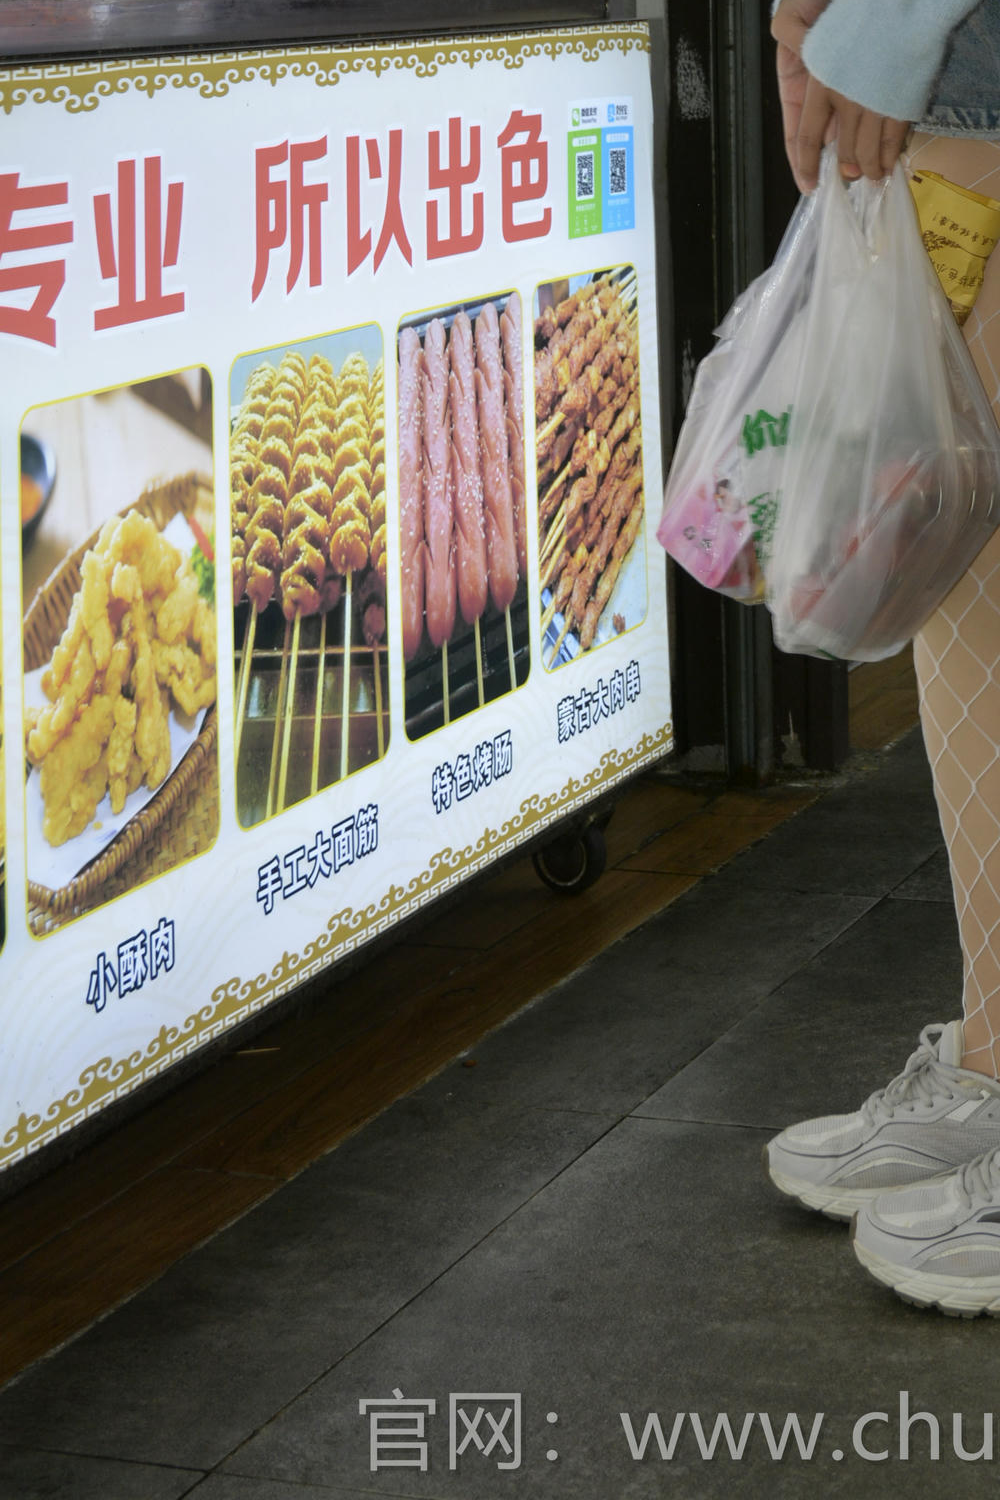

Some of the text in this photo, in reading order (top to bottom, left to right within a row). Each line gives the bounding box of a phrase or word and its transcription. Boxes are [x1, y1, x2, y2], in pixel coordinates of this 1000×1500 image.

[251, 109, 552, 303] 所以出色
[557, 659, 642, 744] 蒙古大肉串
[431, 729, 513, 814] 特色烤肠
[256, 803, 379, 915] 手工大面筋
[86, 917, 176, 1013] 小酥肉
